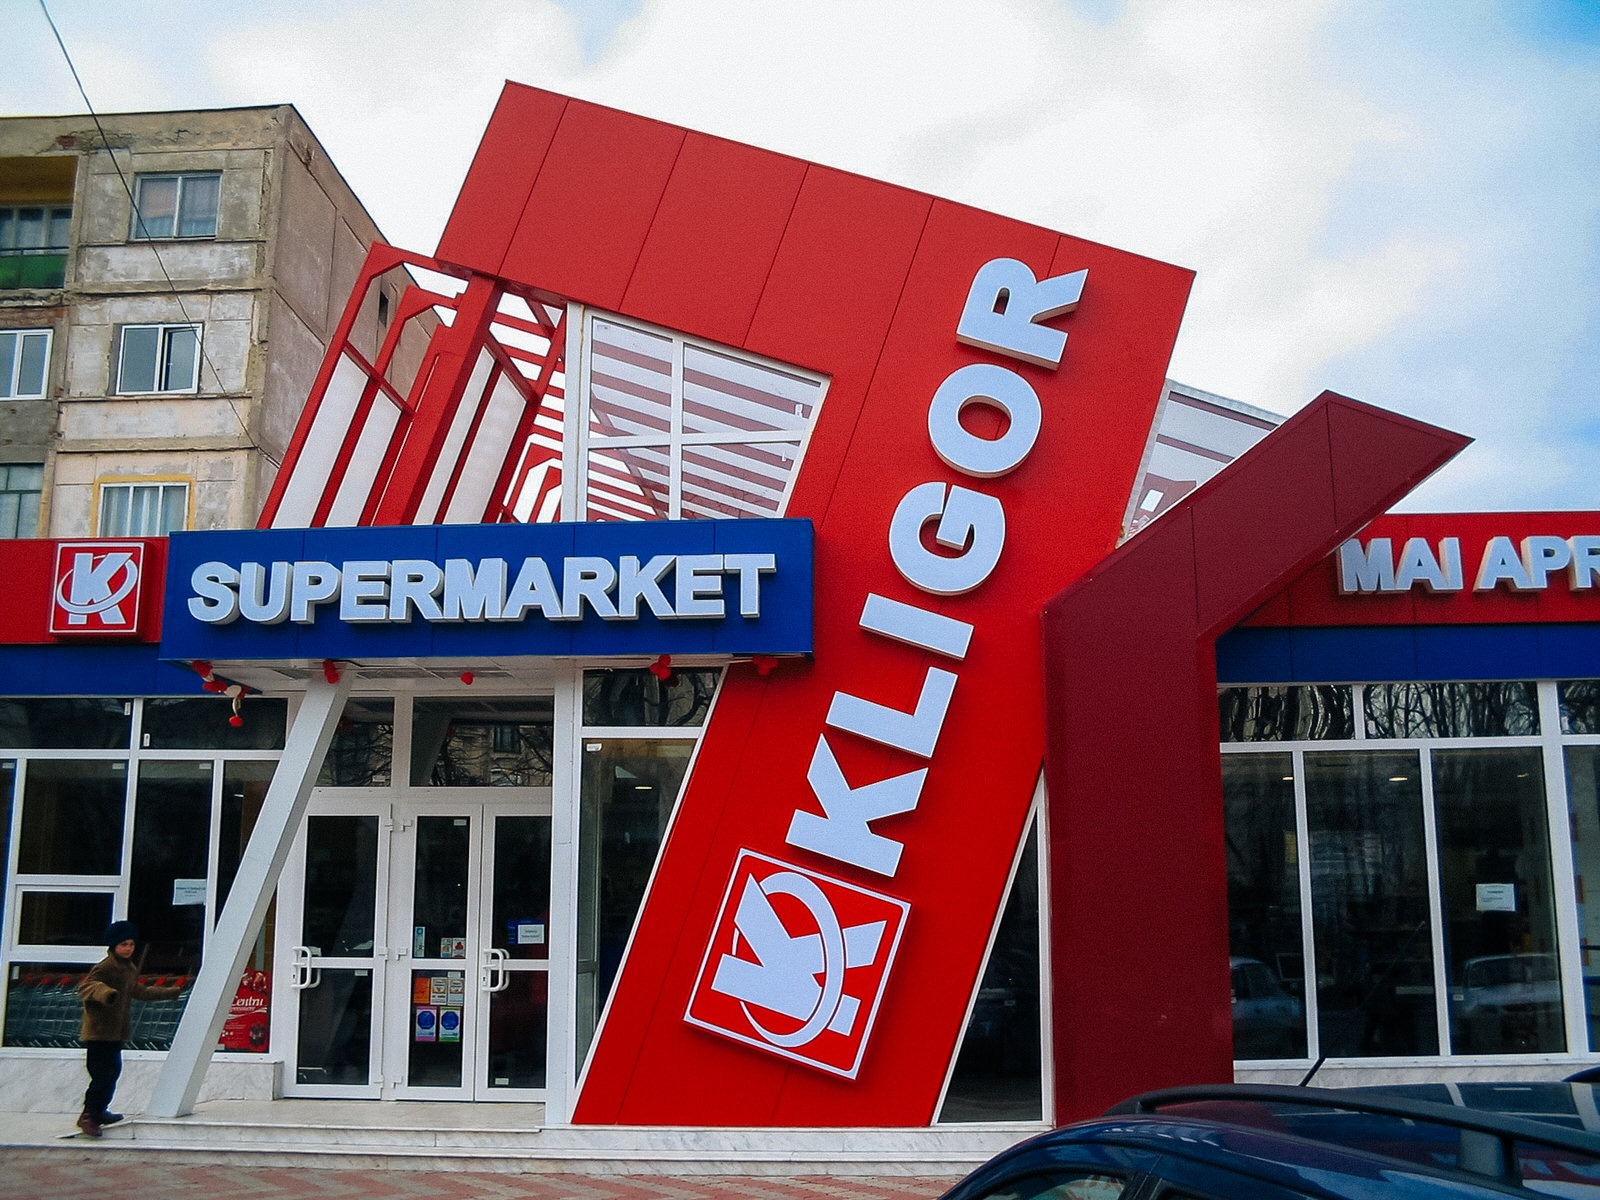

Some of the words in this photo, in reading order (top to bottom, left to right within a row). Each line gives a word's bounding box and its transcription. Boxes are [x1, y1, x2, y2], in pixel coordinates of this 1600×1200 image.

[56, 552, 138, 625] K
[187, 553, 777, 624] SUPERMARKET
[785, 256, 1089, 878] KLIGOR
[1336, 537, 1464, 595] MAI
